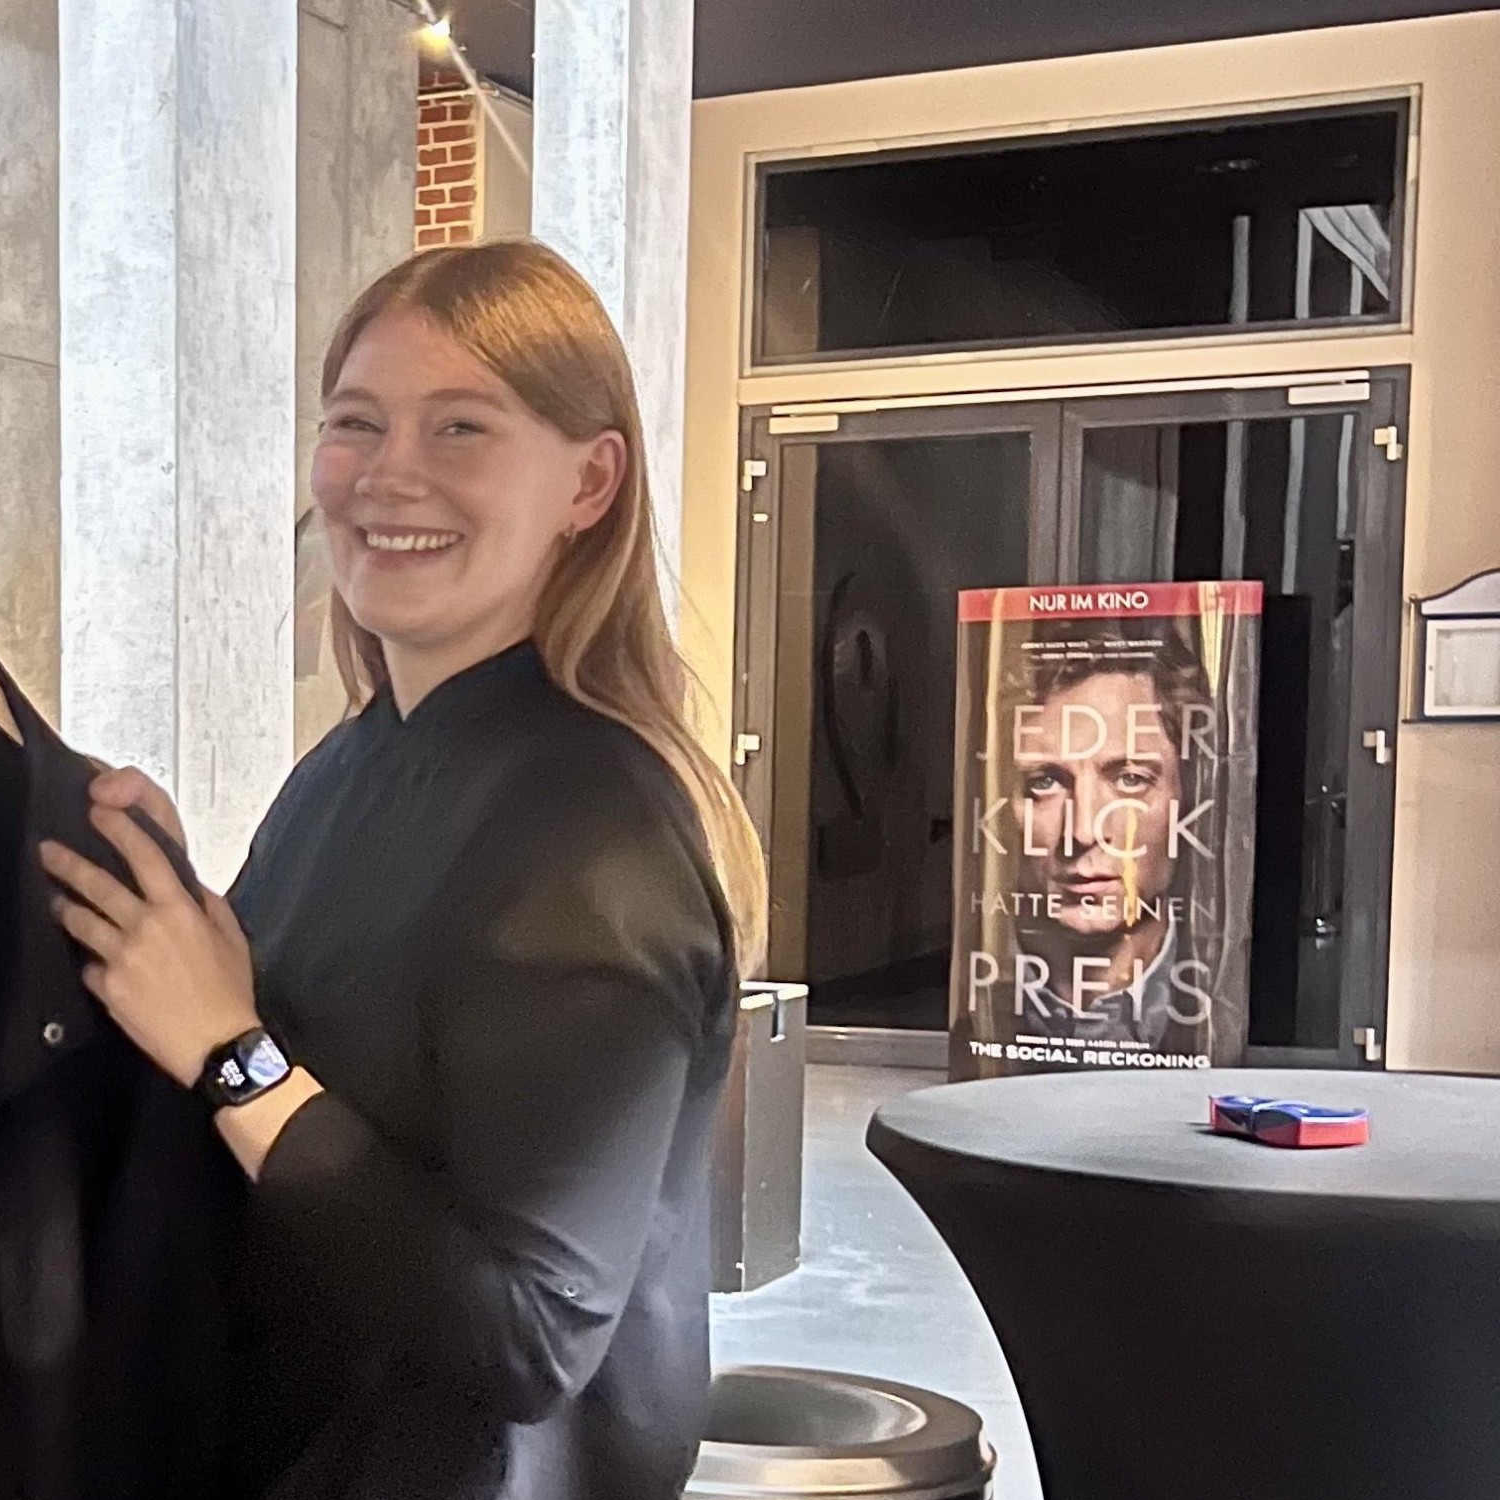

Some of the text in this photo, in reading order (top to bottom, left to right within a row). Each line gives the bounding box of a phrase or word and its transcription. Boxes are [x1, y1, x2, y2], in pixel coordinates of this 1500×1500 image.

[1029, 591, 1149, 611] NUR IM KINO
[976, 703, 1217, 761] EDER
[972, 797, 1216, 859] KLICK
[1080, 894, 1217, 922] SEINEN
[968, 951, 1213, 1026] PREIS
[969, 1041, 1003, 1058] THE
[1005, 1044, 1078, 1064] SOCIAL
[1083, 1051, 1211, 1069] RECKONING
